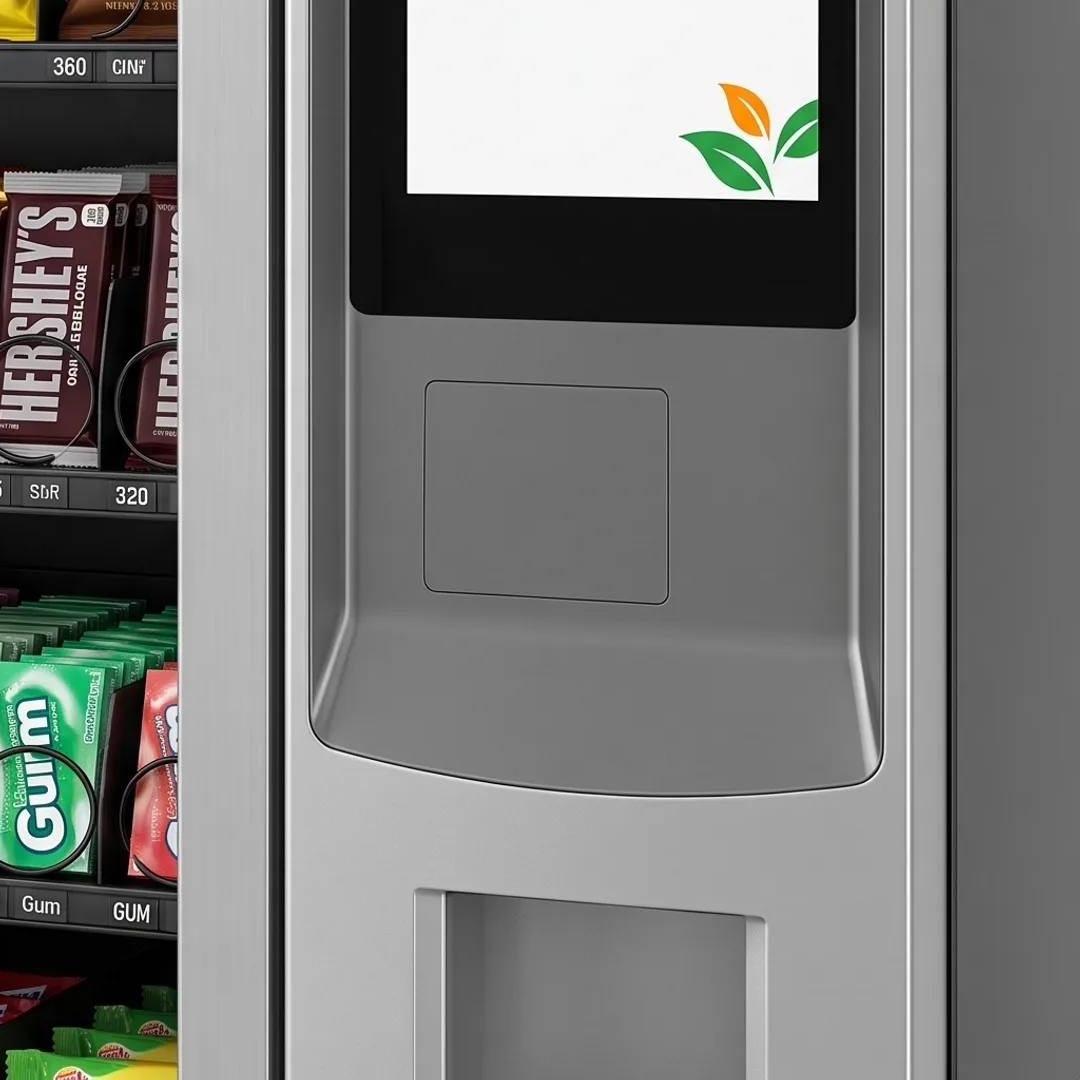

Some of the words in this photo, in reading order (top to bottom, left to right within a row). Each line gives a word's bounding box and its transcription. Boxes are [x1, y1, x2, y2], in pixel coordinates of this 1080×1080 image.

[53, 56, 87, 76] 360
[115, 487, 148, 506] 320
[21, 895, 61, 916] Gum
[113, 903, 151, 924] GUM
